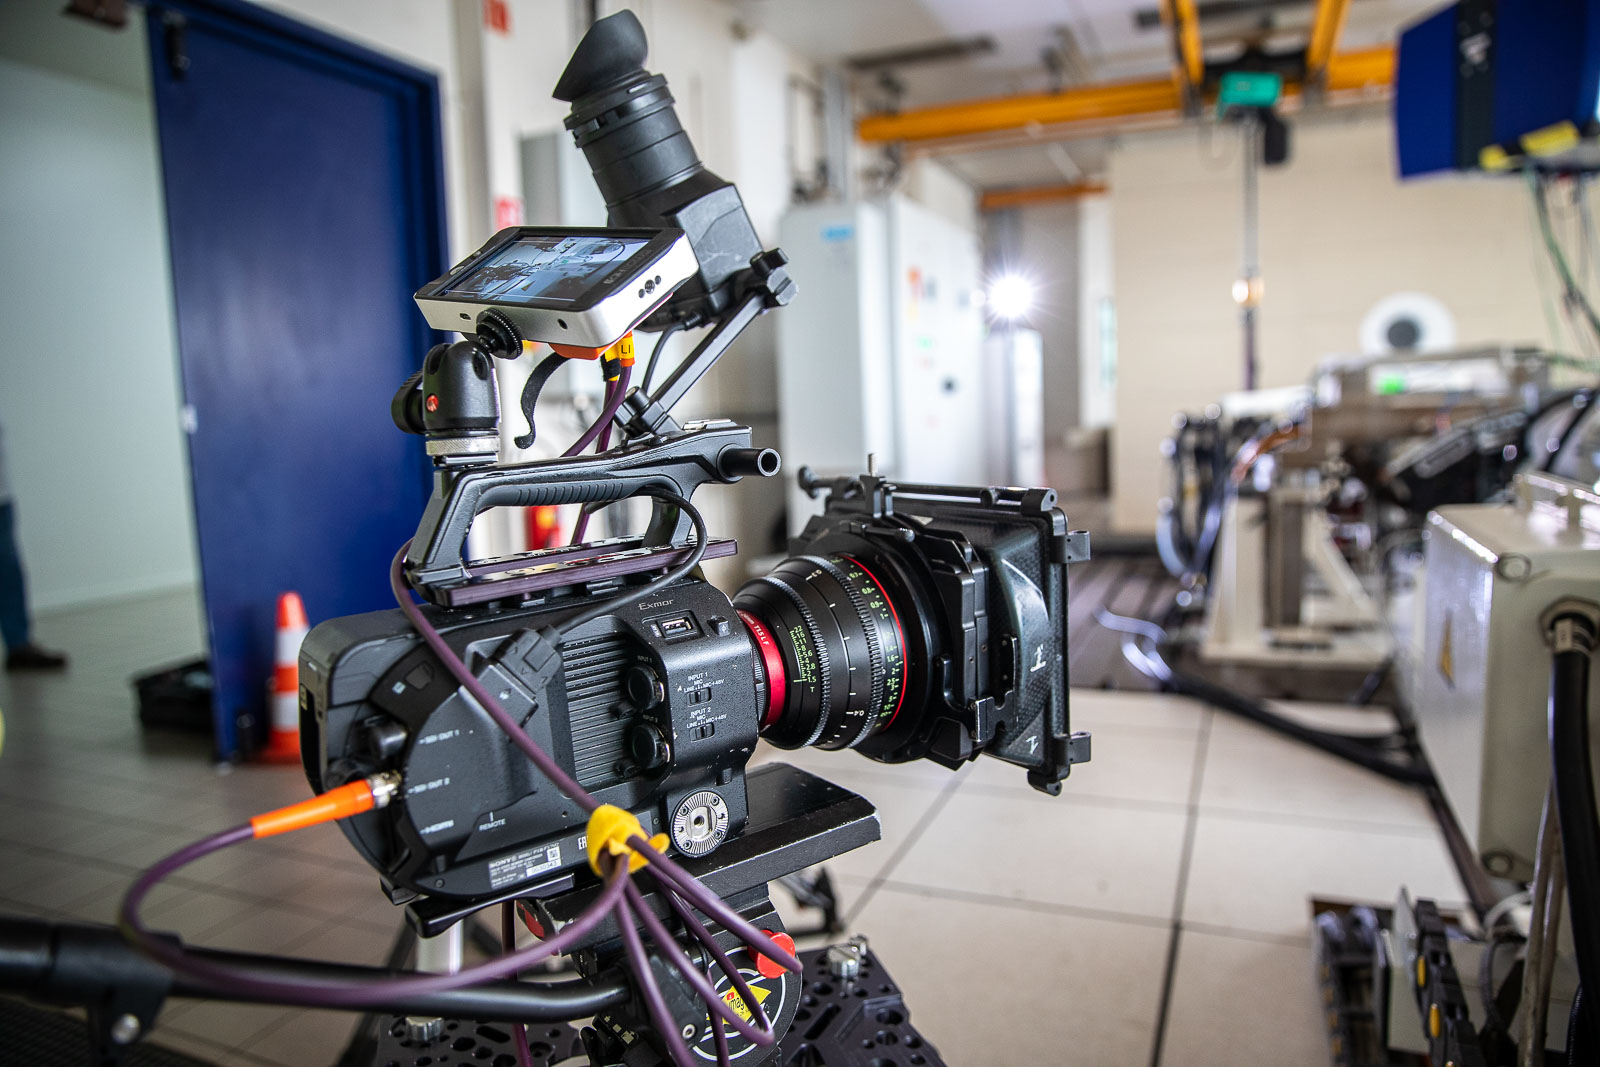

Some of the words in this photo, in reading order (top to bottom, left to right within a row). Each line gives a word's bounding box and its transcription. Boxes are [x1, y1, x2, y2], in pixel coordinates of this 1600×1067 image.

[638, 599, 674, 611] Exmor
[687, 673, 704, 682] INPUT
[690, 710, 706, 718] INPUT
[438, 730, 453, 740] OUT
[479, 819, 505, 831] REMOTE
[489, 857, 511, 869] SONY
